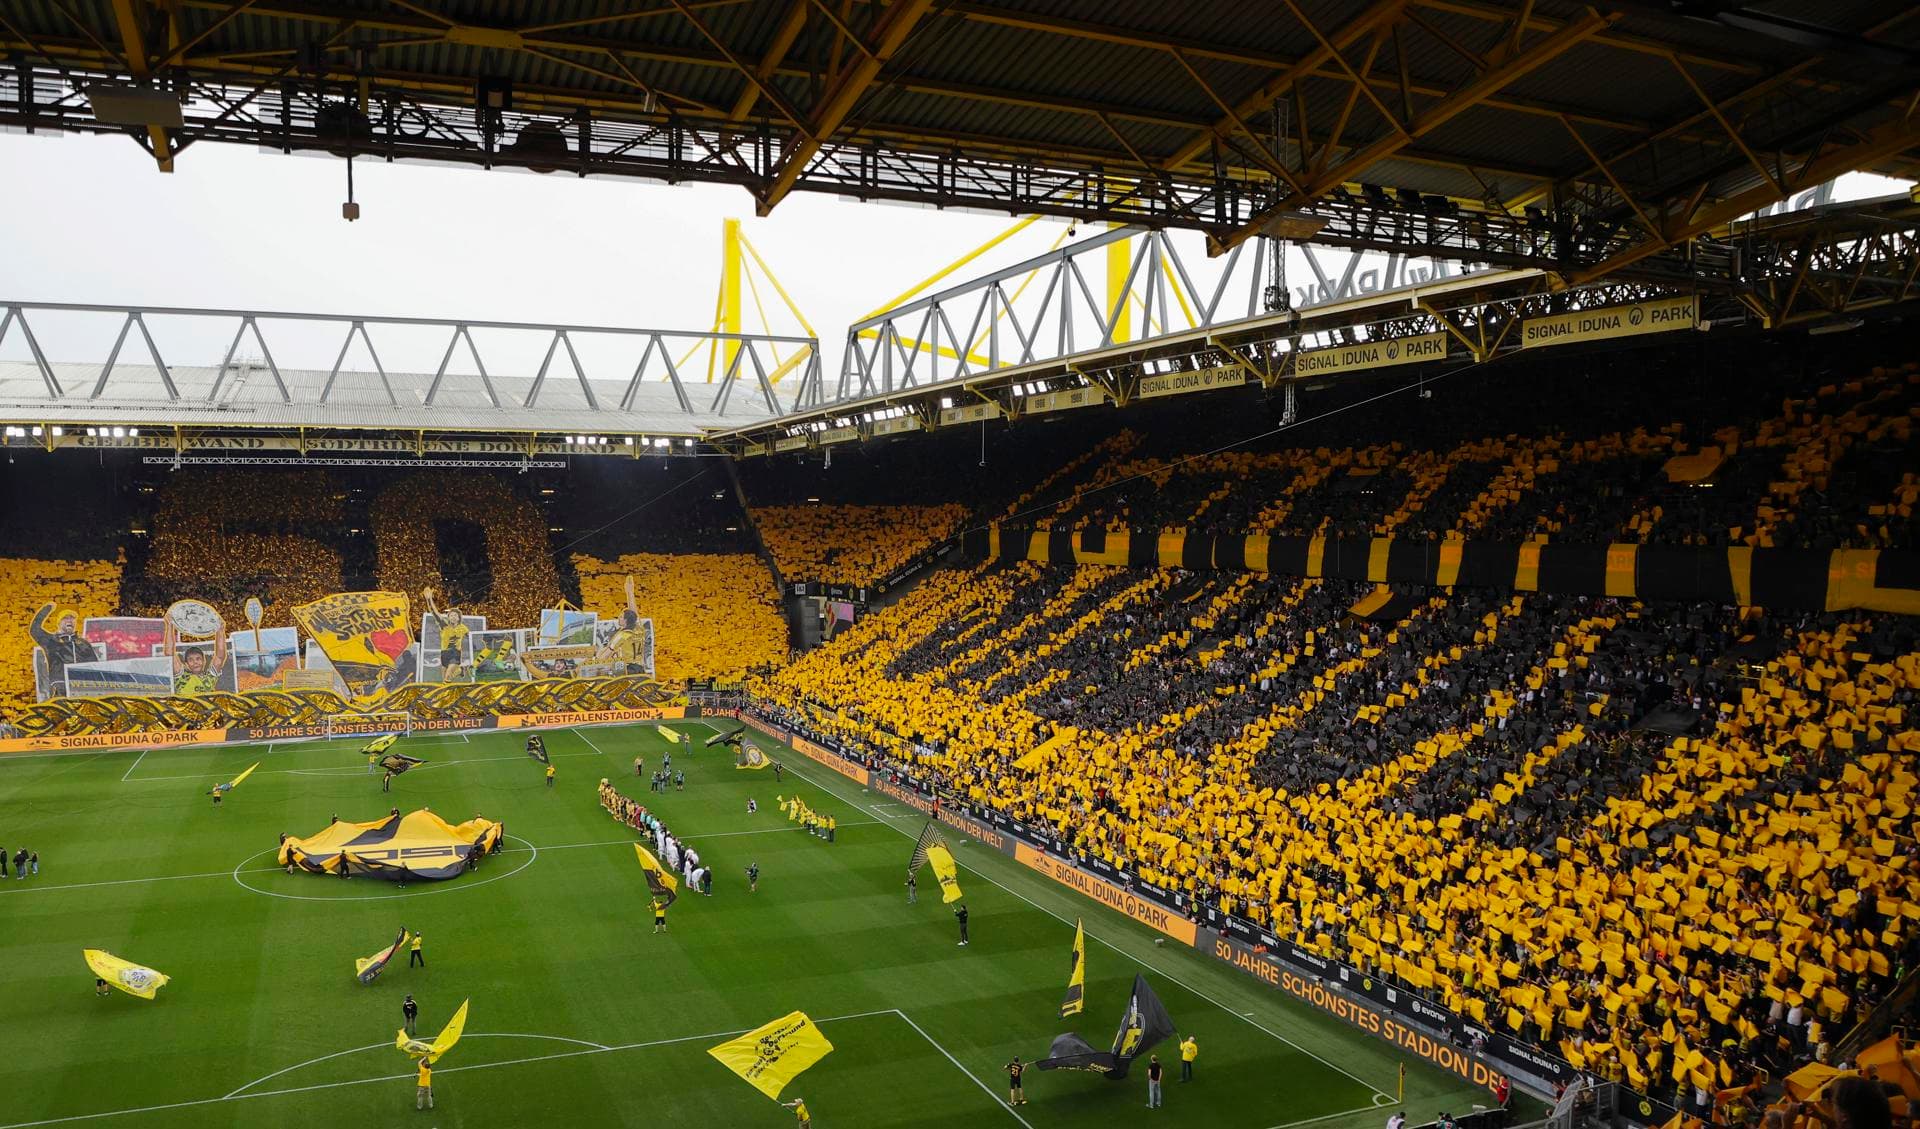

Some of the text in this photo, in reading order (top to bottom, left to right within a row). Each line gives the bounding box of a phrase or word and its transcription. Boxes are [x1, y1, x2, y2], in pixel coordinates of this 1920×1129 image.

[1527, 305, 1693, 340] SIGNAL IDUNA PARK
[1297, 338, 1443, 373] SIGNAL IDUNA PARK
[1141, 368, 1242, 394] SIGNAL IDUNA PARK
[77, 436, 265, 449] GELBE WAND
[308, 607, 401, 633] WESTFALEN
[337, 620, 395, 640] STADION
[535, 710, 651, 724] WESTFALENSTADION
[701, 707, 712, 716] 50
[60, 731, 198, 748] SIGNAL IDUNA PARK
[249, 717, 484, 738] 50 JAHRE SCHÖNSTES STADION DER WELT
[900, 789, 934, 815] SCHÖNSTE
[936, 808, 967, 832] STADION
[966, 821, 982, 838] DER
[982, 829, 1004, 849] WELT
[1055, 864, 1169, 931] SIGNAL IDUNA PARK
[1215, 940, 1232, 960] 50
[1233, 949, 1279, 985] JAHRE
[1282, 972, 1379, 1034] SCHÖNSTES
[1383, 1020, 1469, 1078] STADION
[1508, 1045, 1553, 1070] SIGNAL IDUNA
